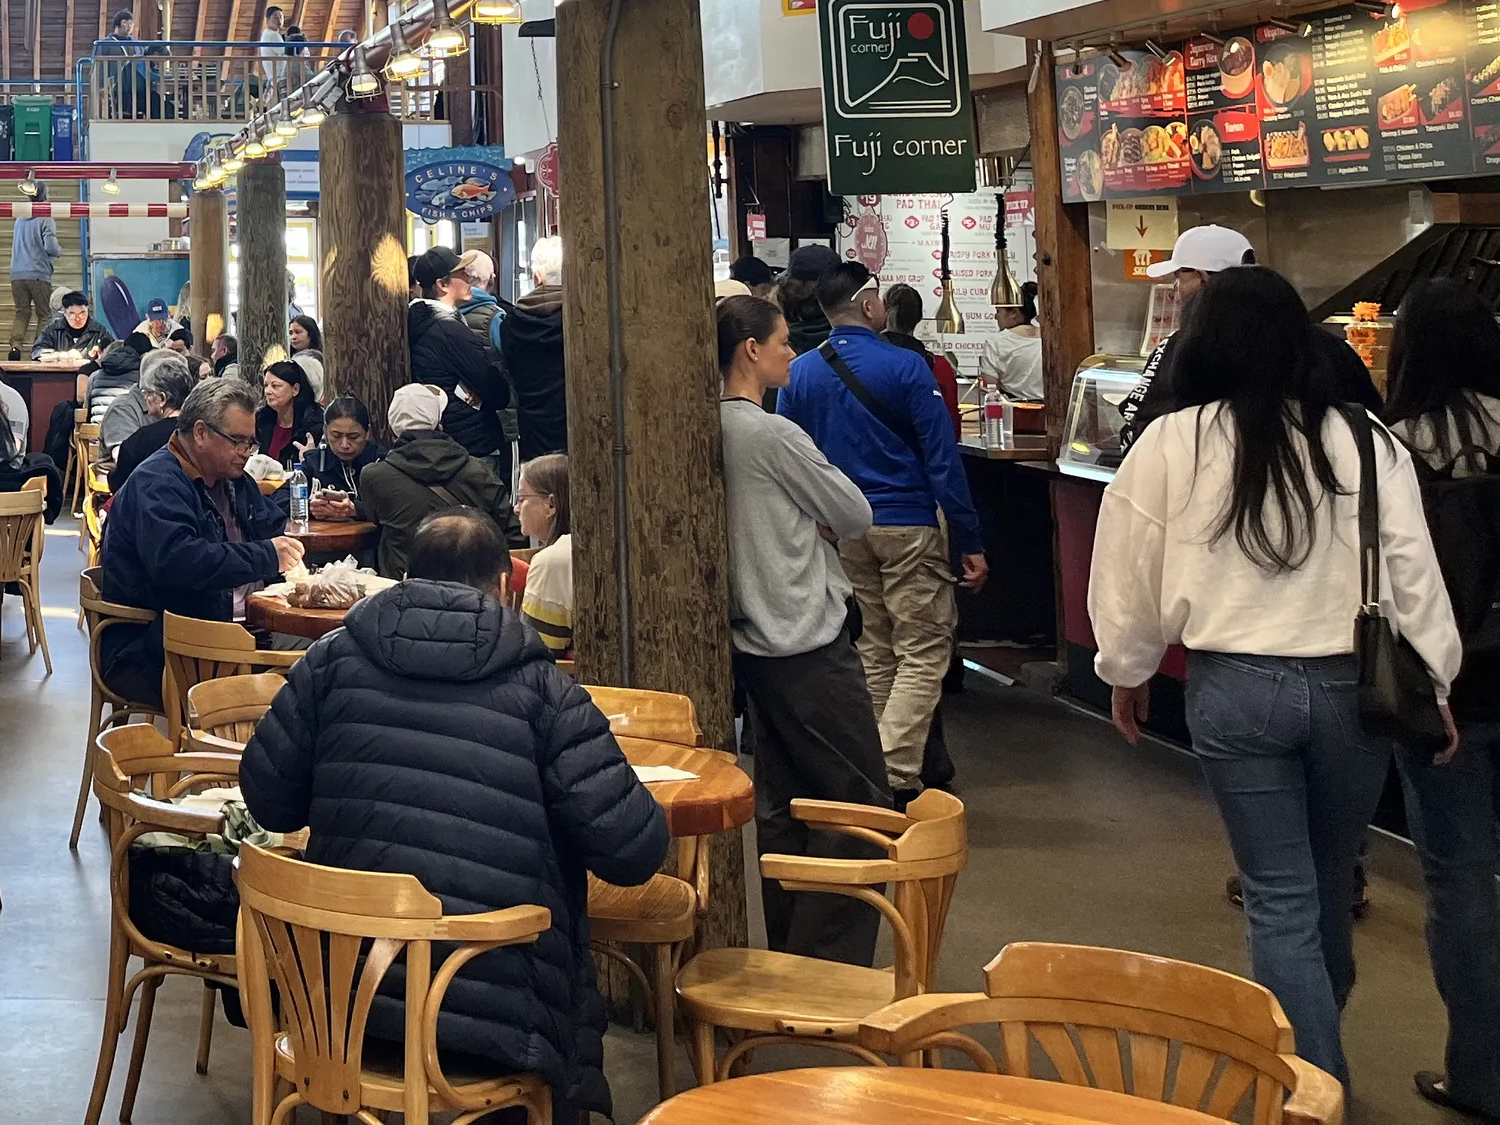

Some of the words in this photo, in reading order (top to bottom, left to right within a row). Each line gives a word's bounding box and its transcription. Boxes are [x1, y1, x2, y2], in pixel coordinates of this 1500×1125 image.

[848, 12, 901, 60] Fuji
[850, 42, 890, 54] corner
[1190, 42, 1214, 54] Japanese
[1190, 57, 1205, 67] Curry
[1206, 54, 1218, 63] Rice
[1225, 122, 1244, 133] Ramen
[834, 131, 882, 176] Fuji
[892, 139, 967, 157] corner
[414, 165, 498, 183] CELINE'S
[896, 199, 914, 210] PAD
[919, 200, 941, 210] THAI
[421, 207, 446, 219] FISH
[461, 204, 493, 218] CHIPS
[979, 215, 992, 223] PAD
[950, 251, 970, 259] RISPY
[972, 251, 991, 259] PORK
[975, 270, 993, 278] PORK
[932, 342, 953, 350] FRED
[955, 342, 986, 350] CHICKEN
[1129, 338, 1170, 402] EXCHANGE
